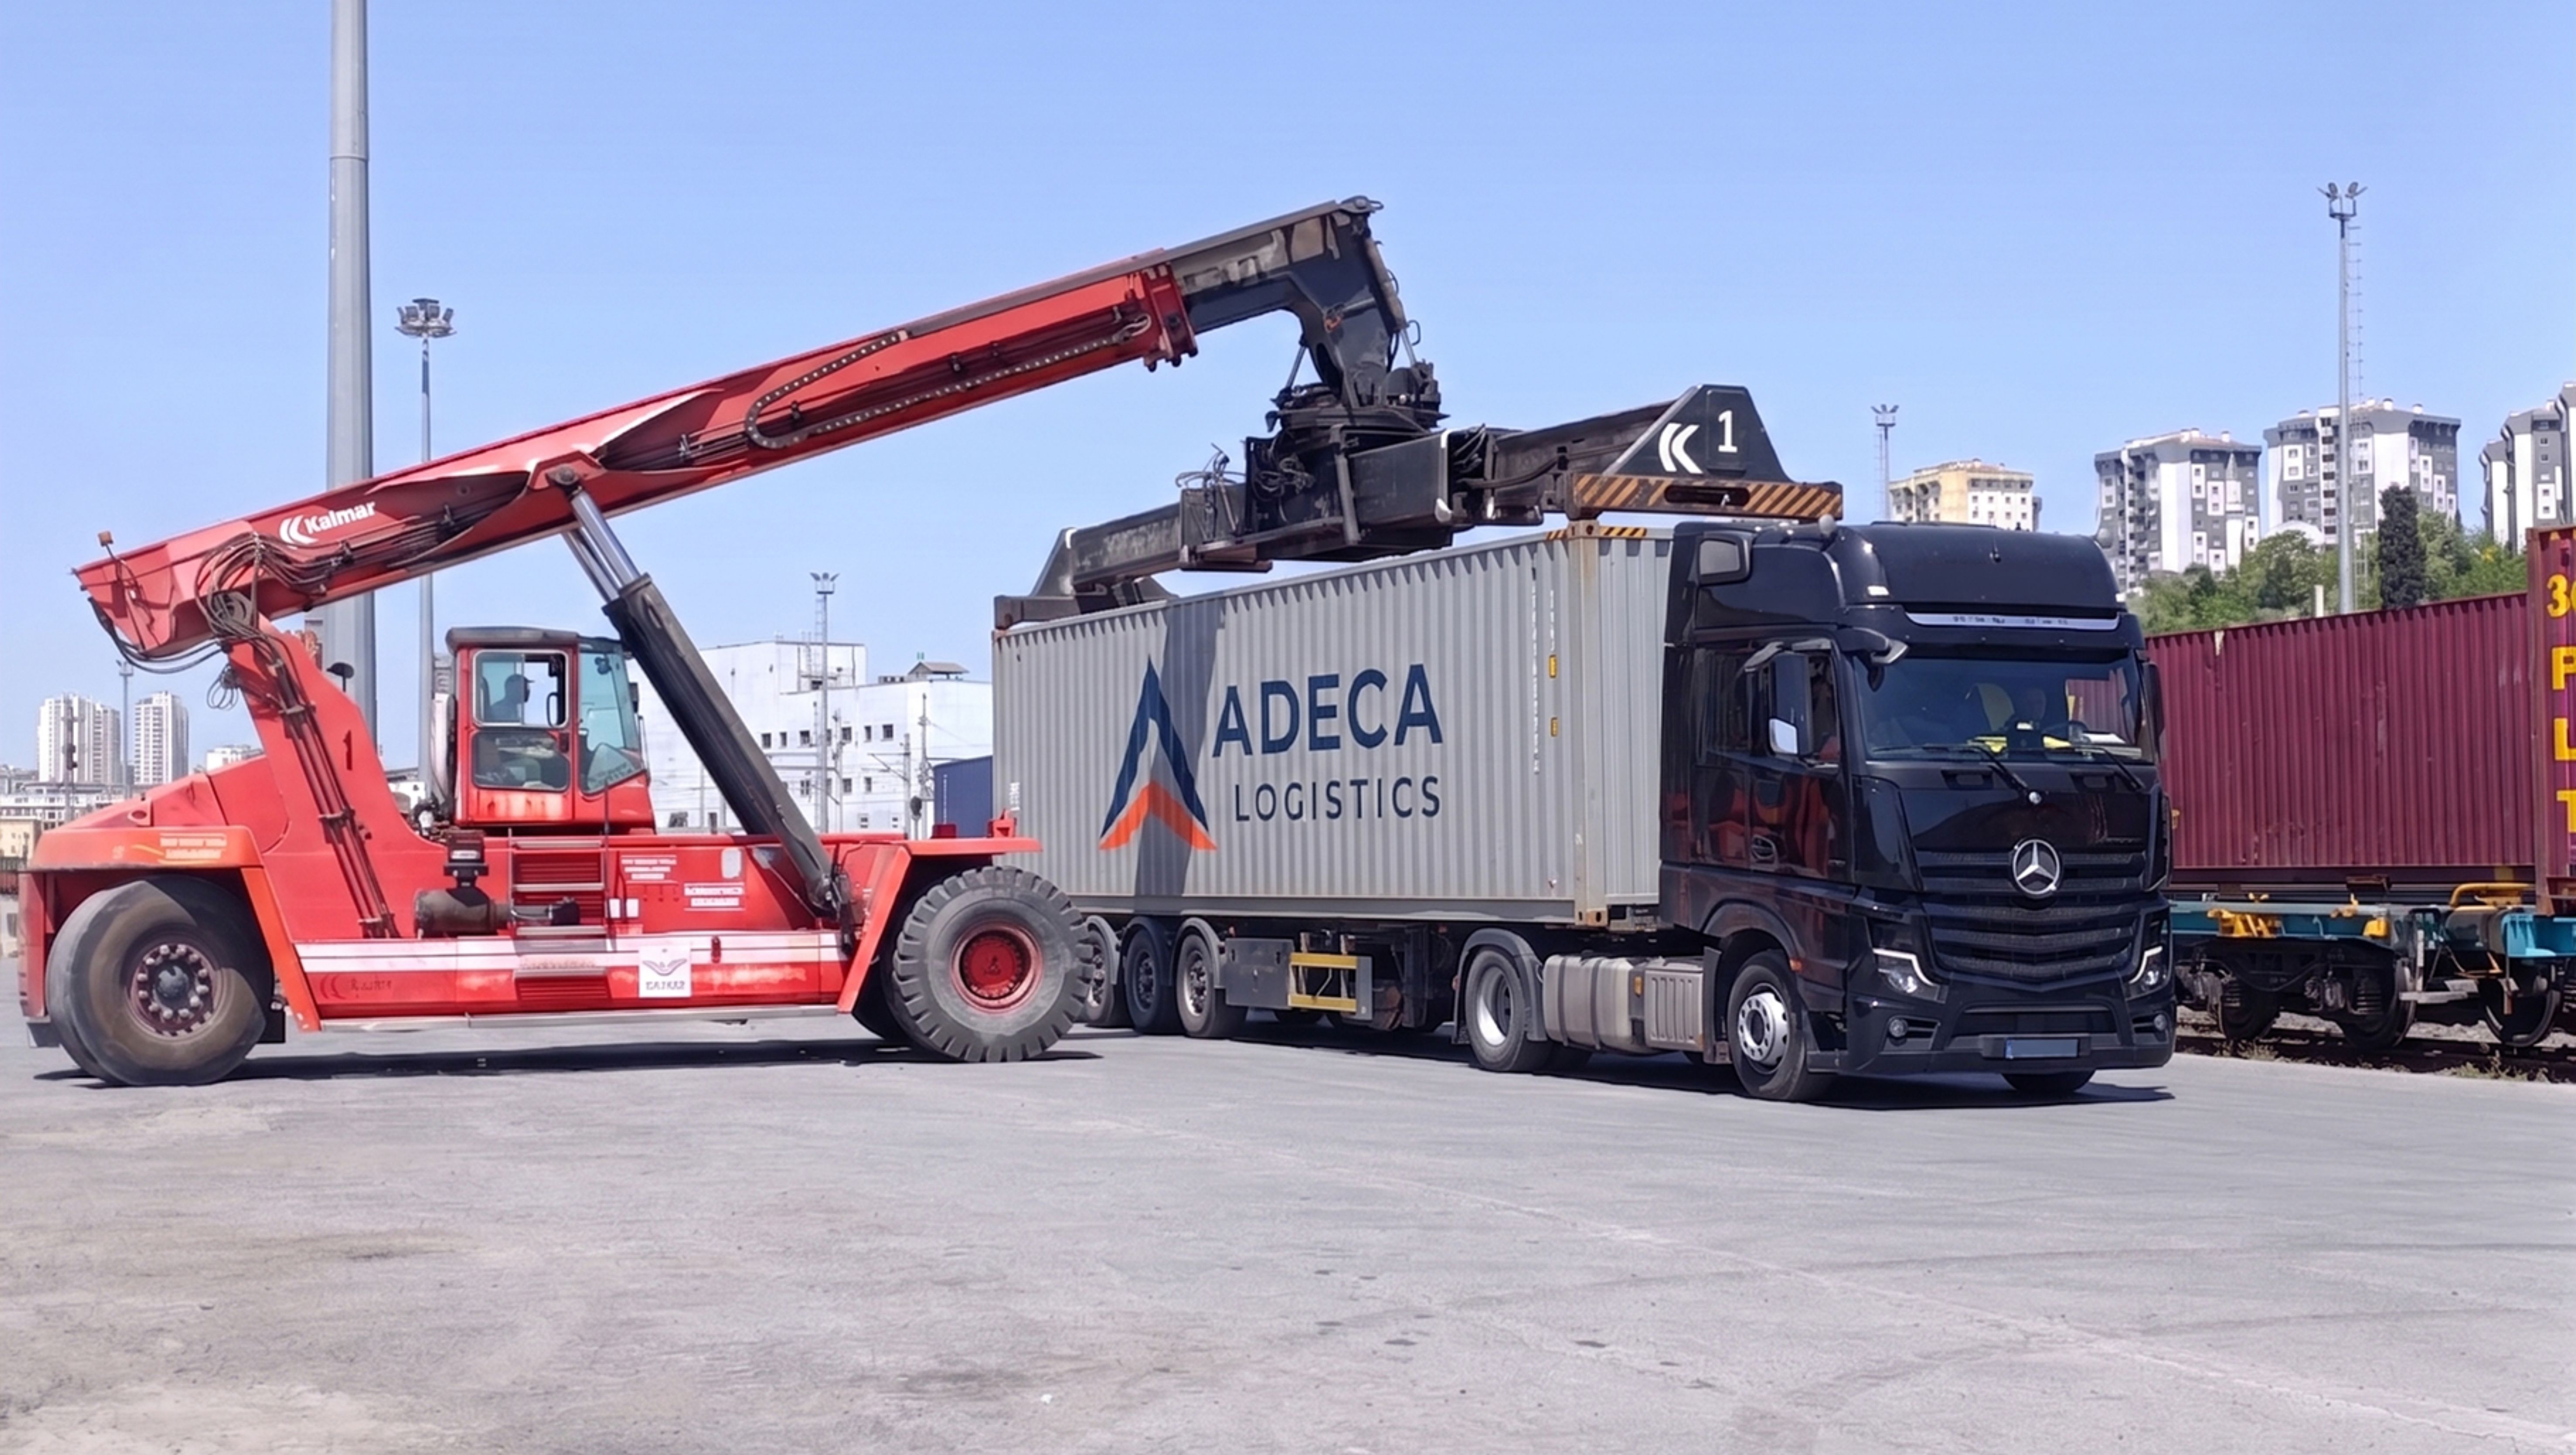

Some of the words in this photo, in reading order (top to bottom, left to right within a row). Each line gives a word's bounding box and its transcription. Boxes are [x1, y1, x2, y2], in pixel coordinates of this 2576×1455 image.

[1718, 409, 1737, 453] 1
[304, 501, 375, 534] Kalmar
[2547, 573, 2576, 617] 3
[1212, 664, 1443, 757] ADECA
[1235, 776, 1440, 821] LOGISTICS
